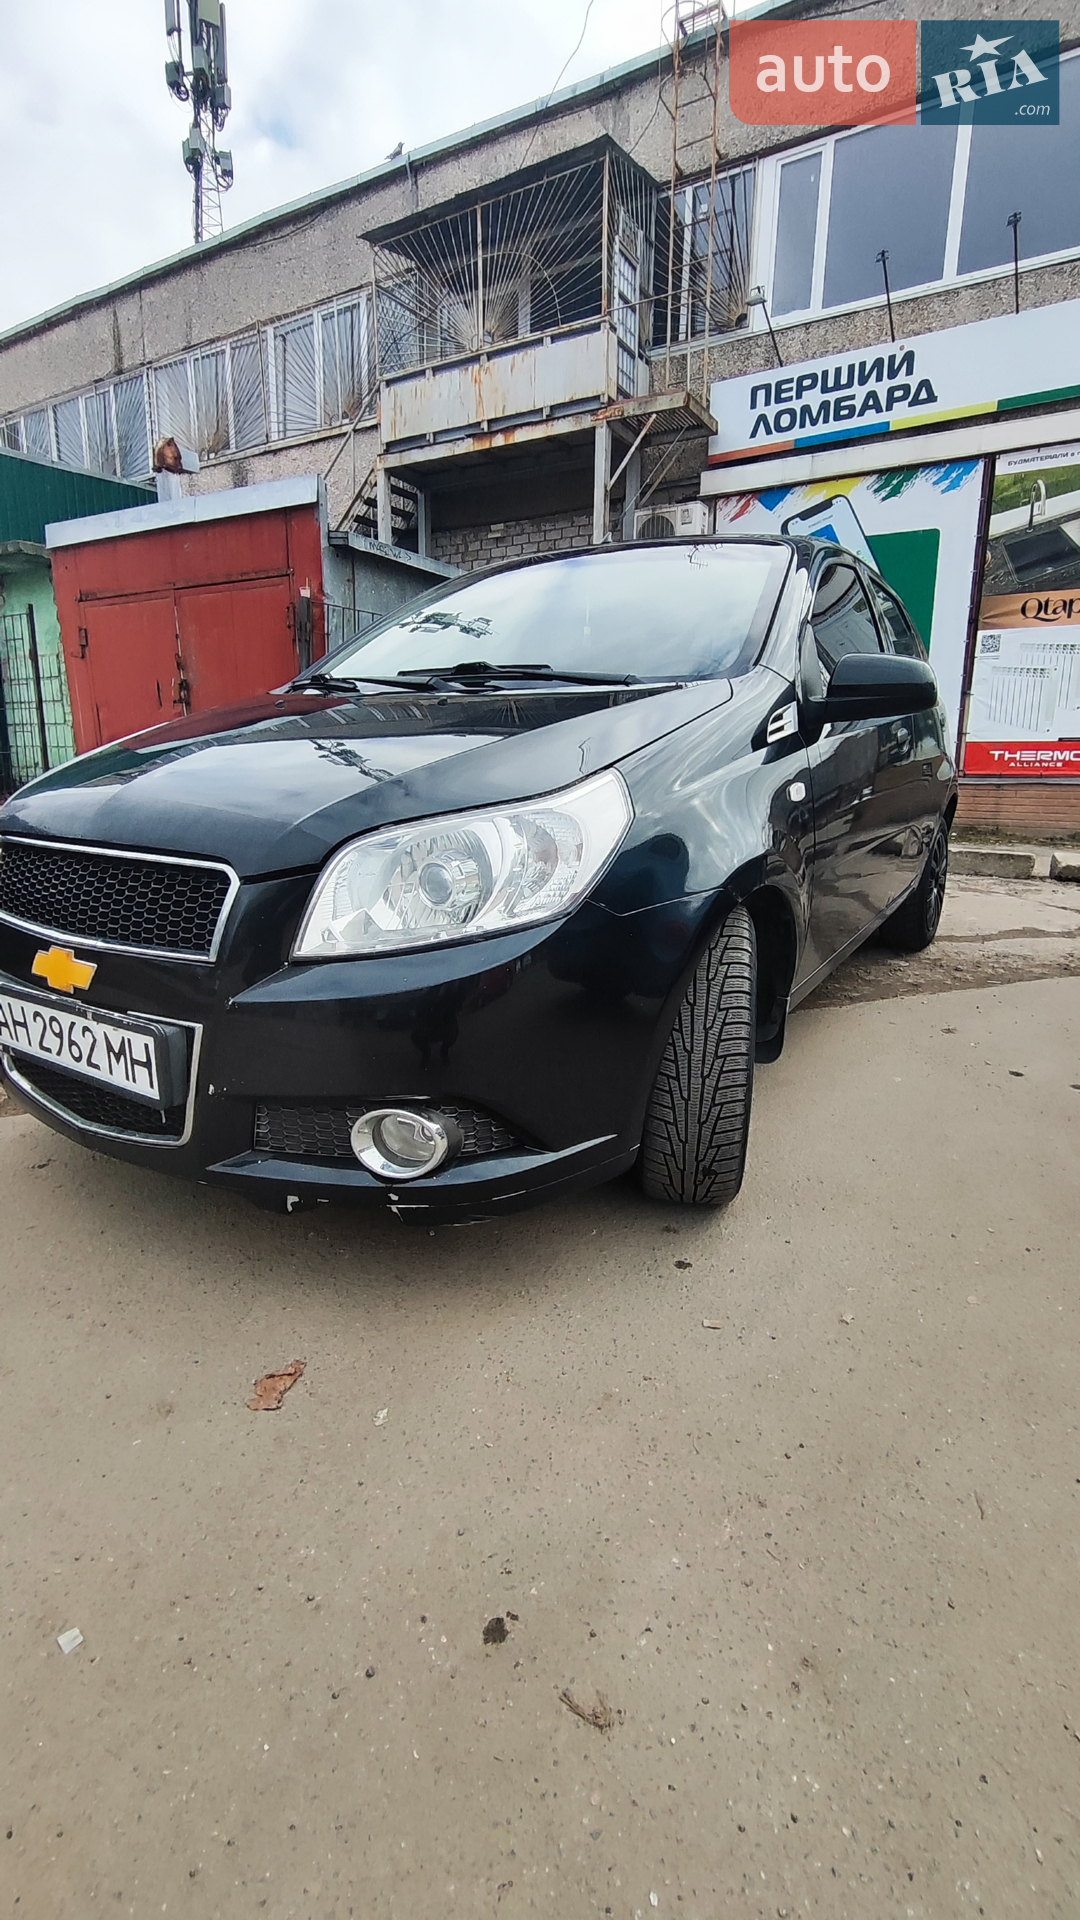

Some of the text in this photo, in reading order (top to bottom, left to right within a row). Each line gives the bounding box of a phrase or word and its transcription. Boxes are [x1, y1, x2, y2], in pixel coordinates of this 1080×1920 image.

[749, 378, 938, 439] ЛОМБАРД
[750, 344, 915, 410] ПЕРШИЙ
[1021, 597, 1080, 622] Qtap
[33, 1010, 101, 1071] 2962
[103, 1030, 154, 1090] MH
